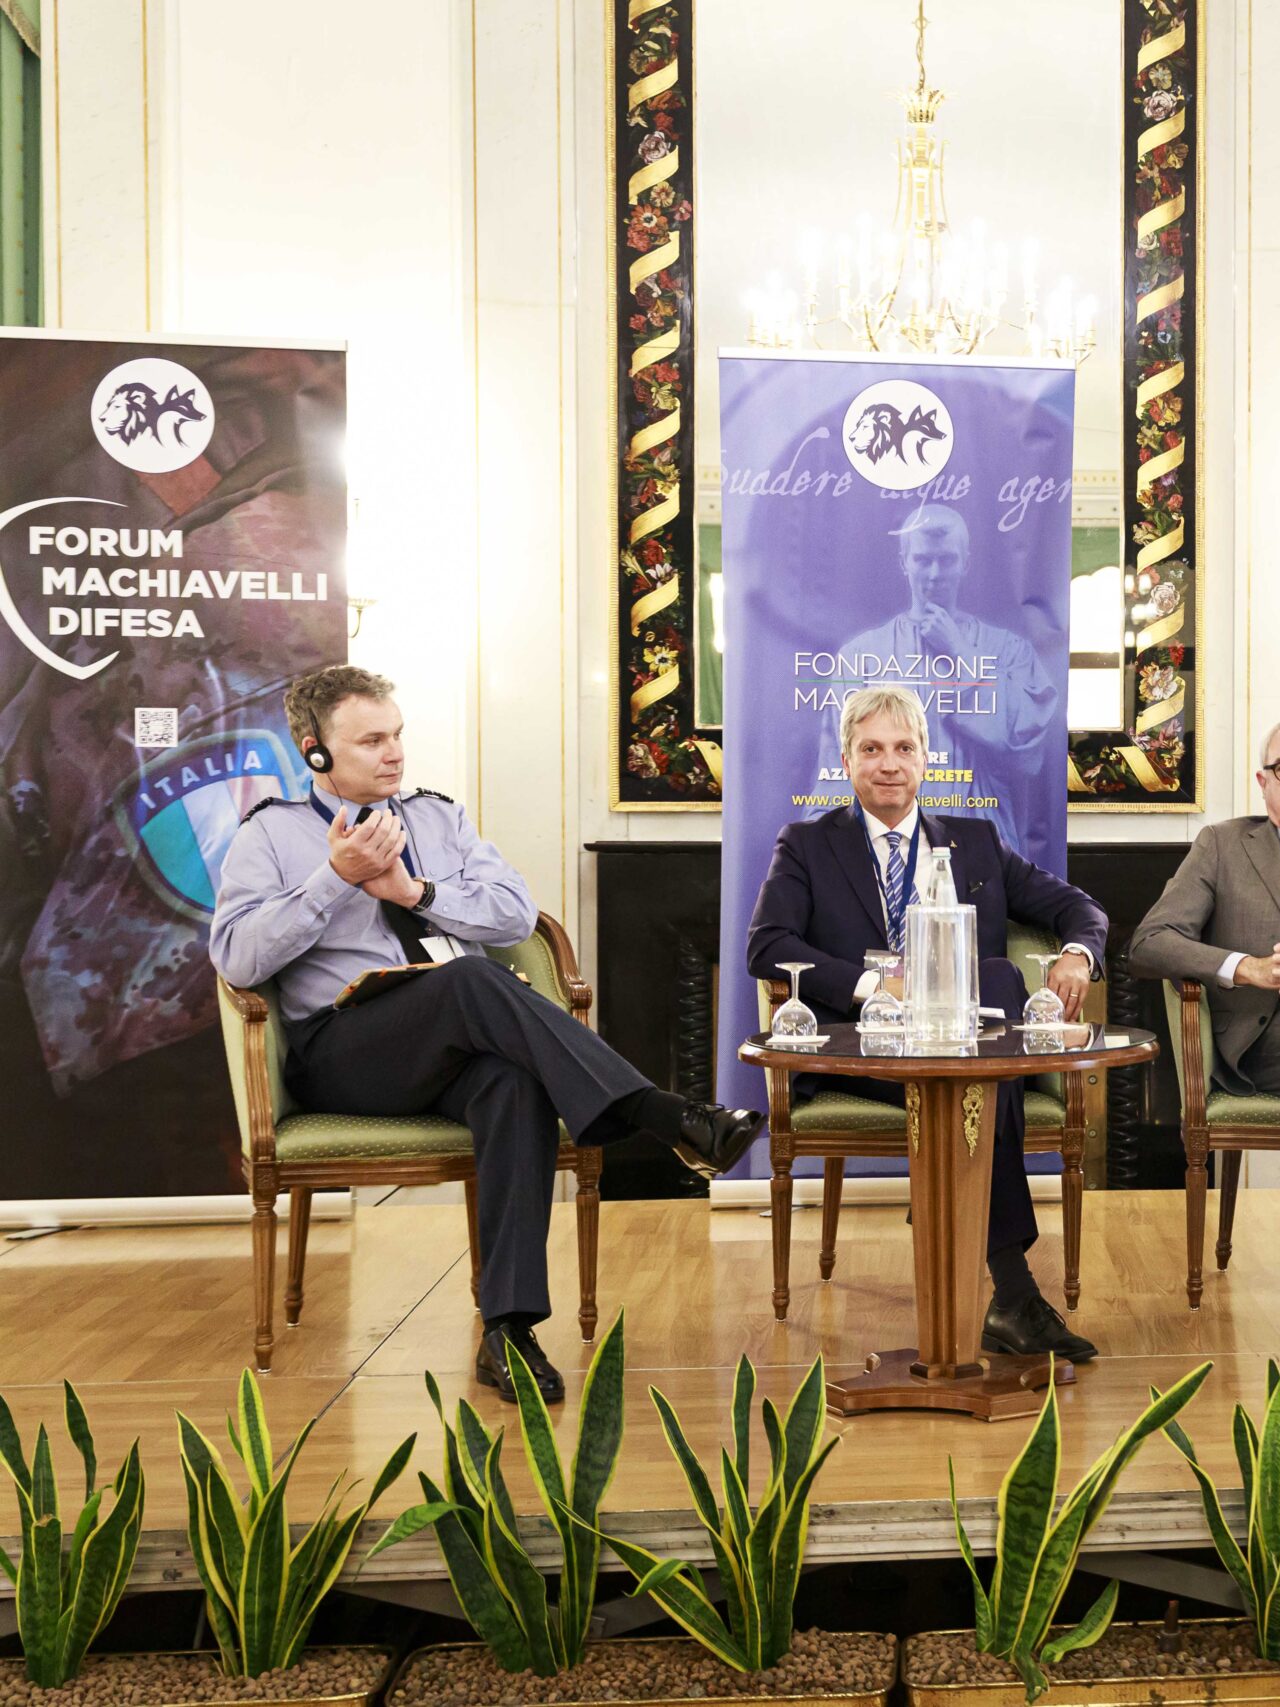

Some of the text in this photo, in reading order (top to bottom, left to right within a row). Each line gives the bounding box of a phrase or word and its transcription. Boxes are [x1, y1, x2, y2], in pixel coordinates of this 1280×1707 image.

[721, 427, 853, 497] uadere
[29, 526, 183, 558] FORUM
[42, 566, 328, 601] MACHIAVELLI
[49, 606, 205, 638] DIFESA
[795, 652, 998, 679] FONDAZIONE
[794, 687, 997, 714] MAVELLI
[139, 750, 262, 809] ITALIA
